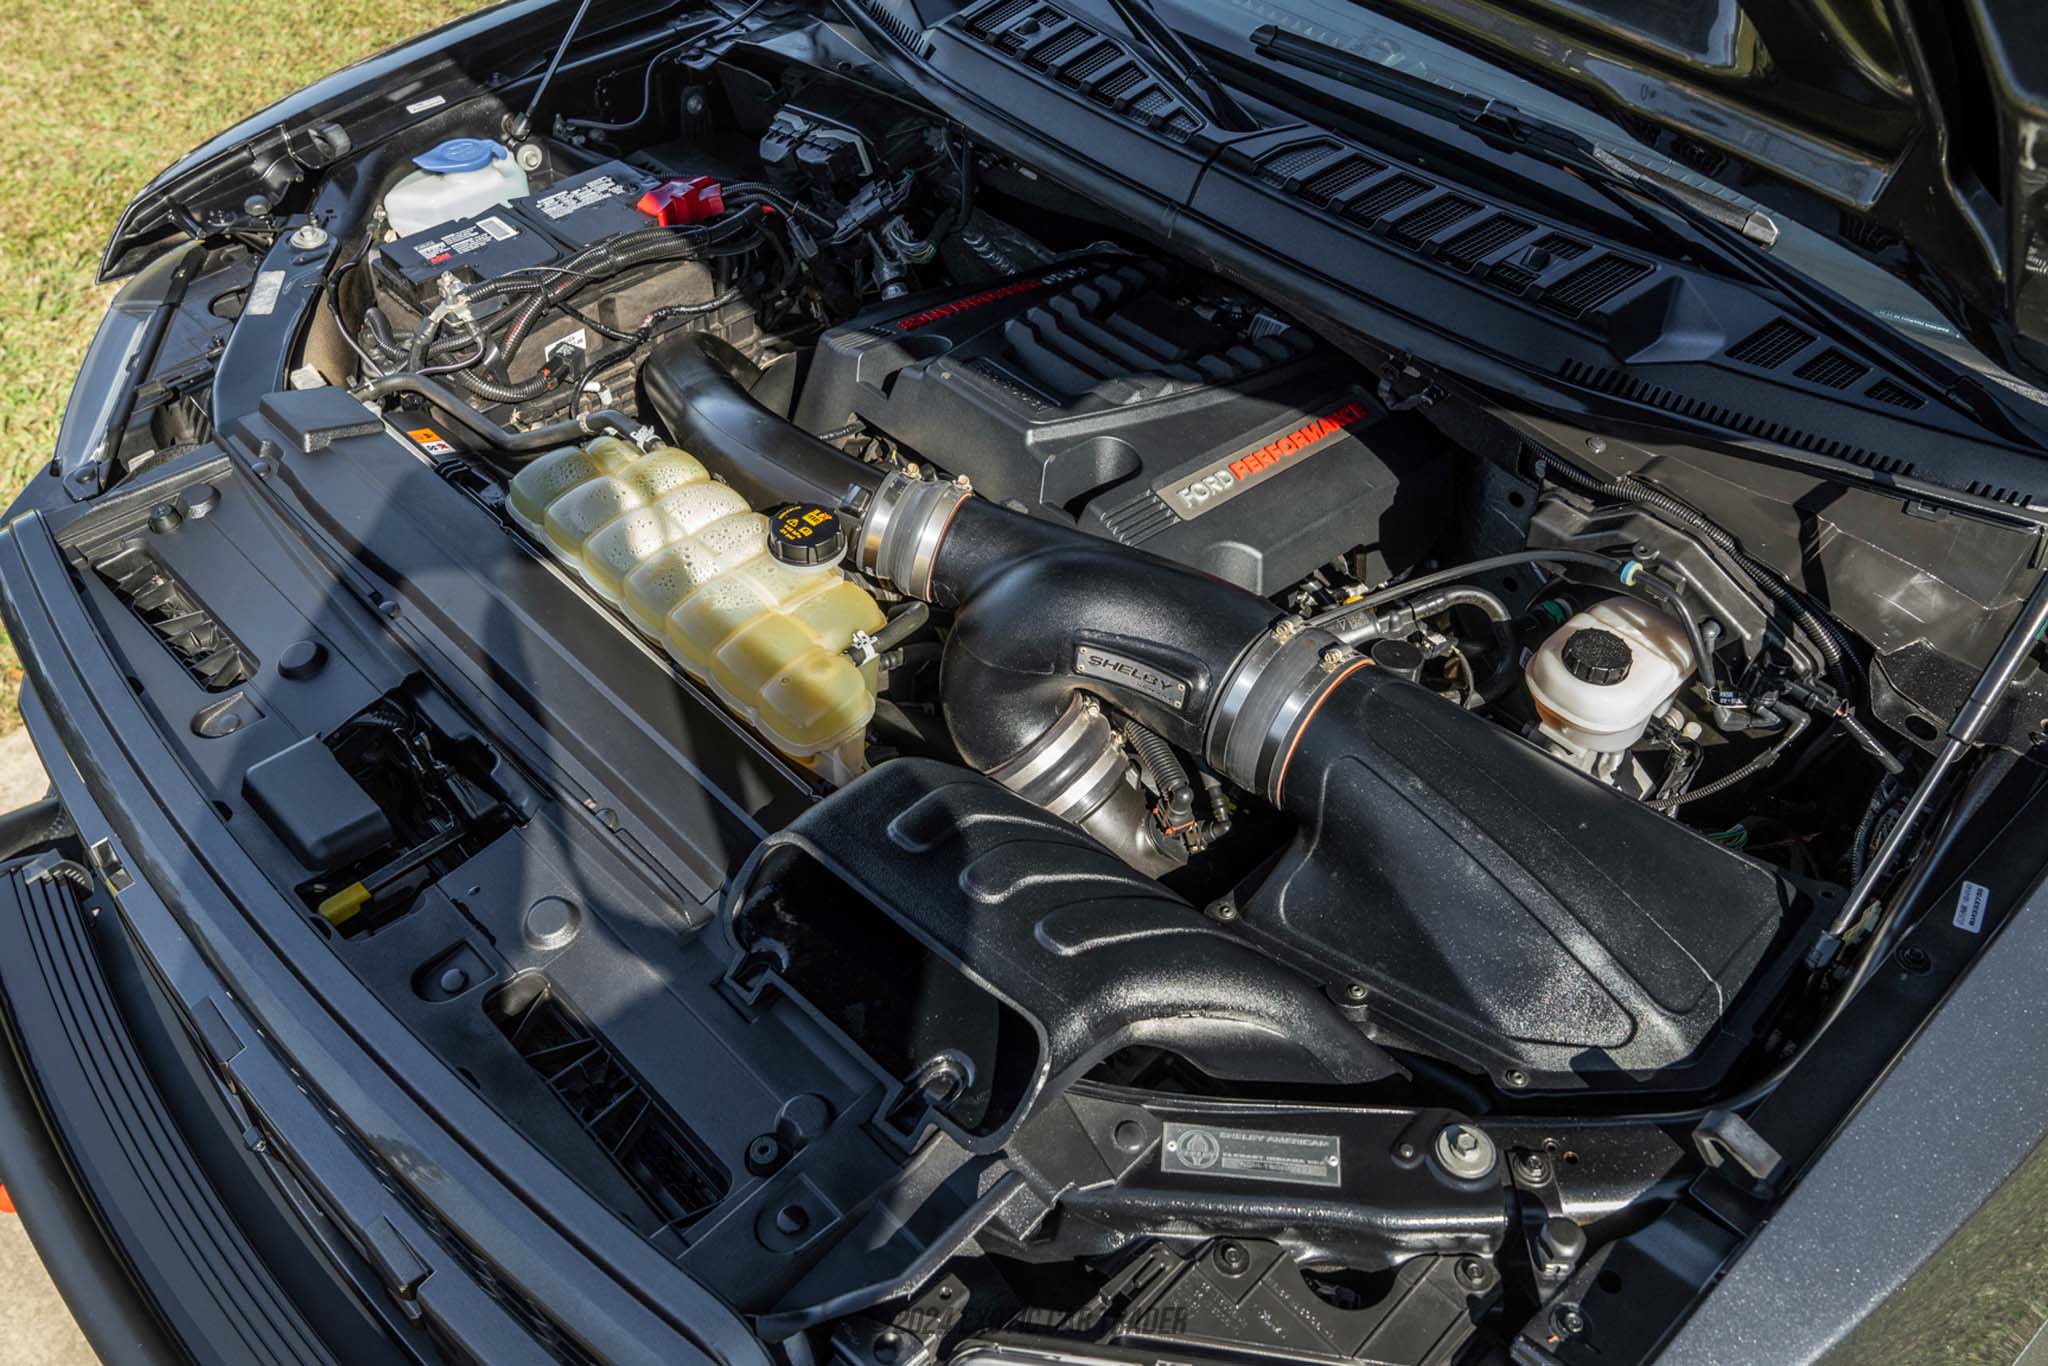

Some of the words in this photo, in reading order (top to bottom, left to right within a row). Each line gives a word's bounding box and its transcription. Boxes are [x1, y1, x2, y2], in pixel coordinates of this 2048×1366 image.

[1177, 470, 1234, 508] FORD
[1229, 403, 1367, 480] PERFORMANCE
[1088, 655, 1173, 690] SHELBY
